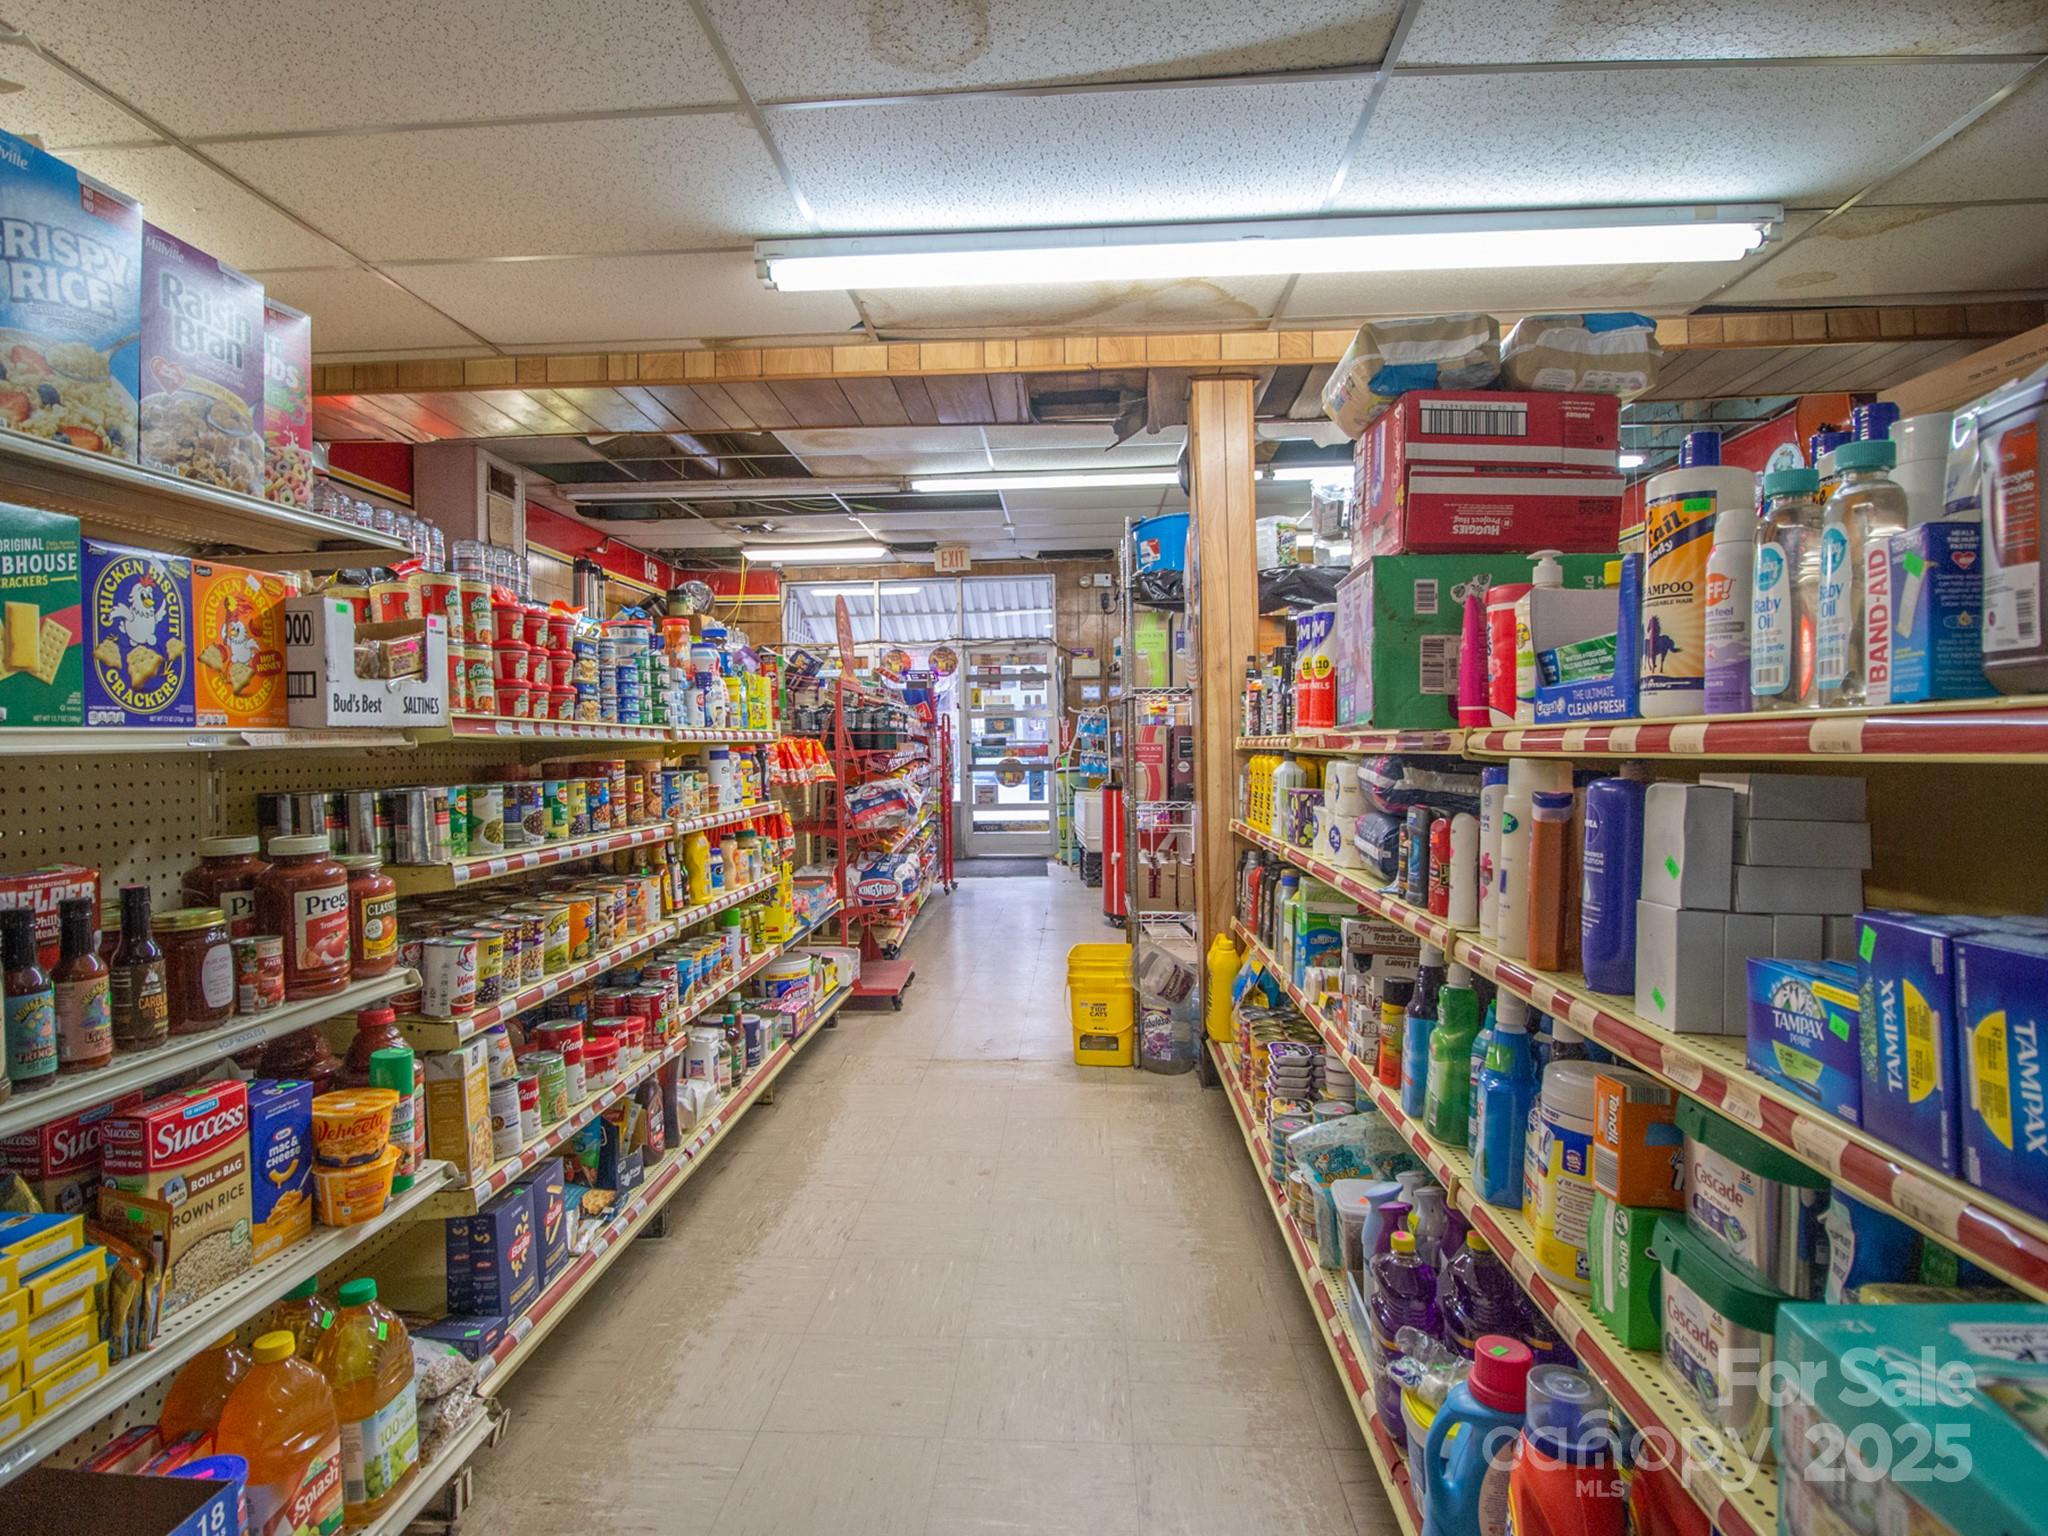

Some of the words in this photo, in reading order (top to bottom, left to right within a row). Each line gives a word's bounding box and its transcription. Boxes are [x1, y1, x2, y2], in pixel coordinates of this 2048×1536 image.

[0, 146, 29, 170] ville
[0, 218, 129, 288] RISPY
[11, 262, 116, 318] RICE
[161, 271, 251, 344] Raisin
[174, 315, 243, 370] Bran
[1452, 524, 1500, 535] HUGGIES
[941, 550, 965, 568] EXIT
[100, 559, 145, 627] CHICKEN
[147, 563, 181, 637] BISCUIT
[1645, 580, 1694, 599] AMPOO
[1754, 595, 1782, 616] Baby
[205, 580, 241, 640] CHICKEN
[244, 586, 273, 646] BISCUIT
[1757, 614, 1774, 630] Oil
[1821, 599, 1836, 617] Oil
[1867, 547, 1889, 685] BAND-AID
[105, 668, 179, 709] CRACKERS
[211, 675, 273, 713] CRACKERS
[333, 693, 360, 713] Bud's
[361, 697, 383, 714] Best
[402, 695, 440, 715] SALTINES
[1572, 689, 1583, 698] THE
[1584, 685, 1616, 698] ULTIMATE
[1567, 702, 1593, 716] CLEAN
[1600, 699, 1626, 713] FRESH
[857, 882, 898, 897] KINGSFORD
[1771, 1009, 1825, 1042] TAMPAX
[1879, 978, 1904, 1093] TAMPAX
[2012, 1019, 2048, 1157] TAMPAX
[103, 1124, 141, 1140] Success
[153, 1103, 245, 1160] Success
[316, 1113, 384, 1143] Velveeta
[1606, 1093, 1621, 1146] Tandil
[104, 1160, 127, 1168] BROWN
[127, 1160, 143, 1169] RICE
[268, 1140, 290, 1158] mac
[190, 1174, 215, 1193] BOIL
[222, 1159, 243, 1177] BAG
[1693, 1161, 1744, 1208] Cascade
[1739, 1170, 1752, 1184] 36
[172, 1199, 215, 1230] ROWN
[217, 1182, 246, 1208] RICE
[1667, 1294, 1719, 1359] Cascade
[1673, 1327, 1708, 1364] PLATINUM
[293, 1465, 340, 1520] Splash
